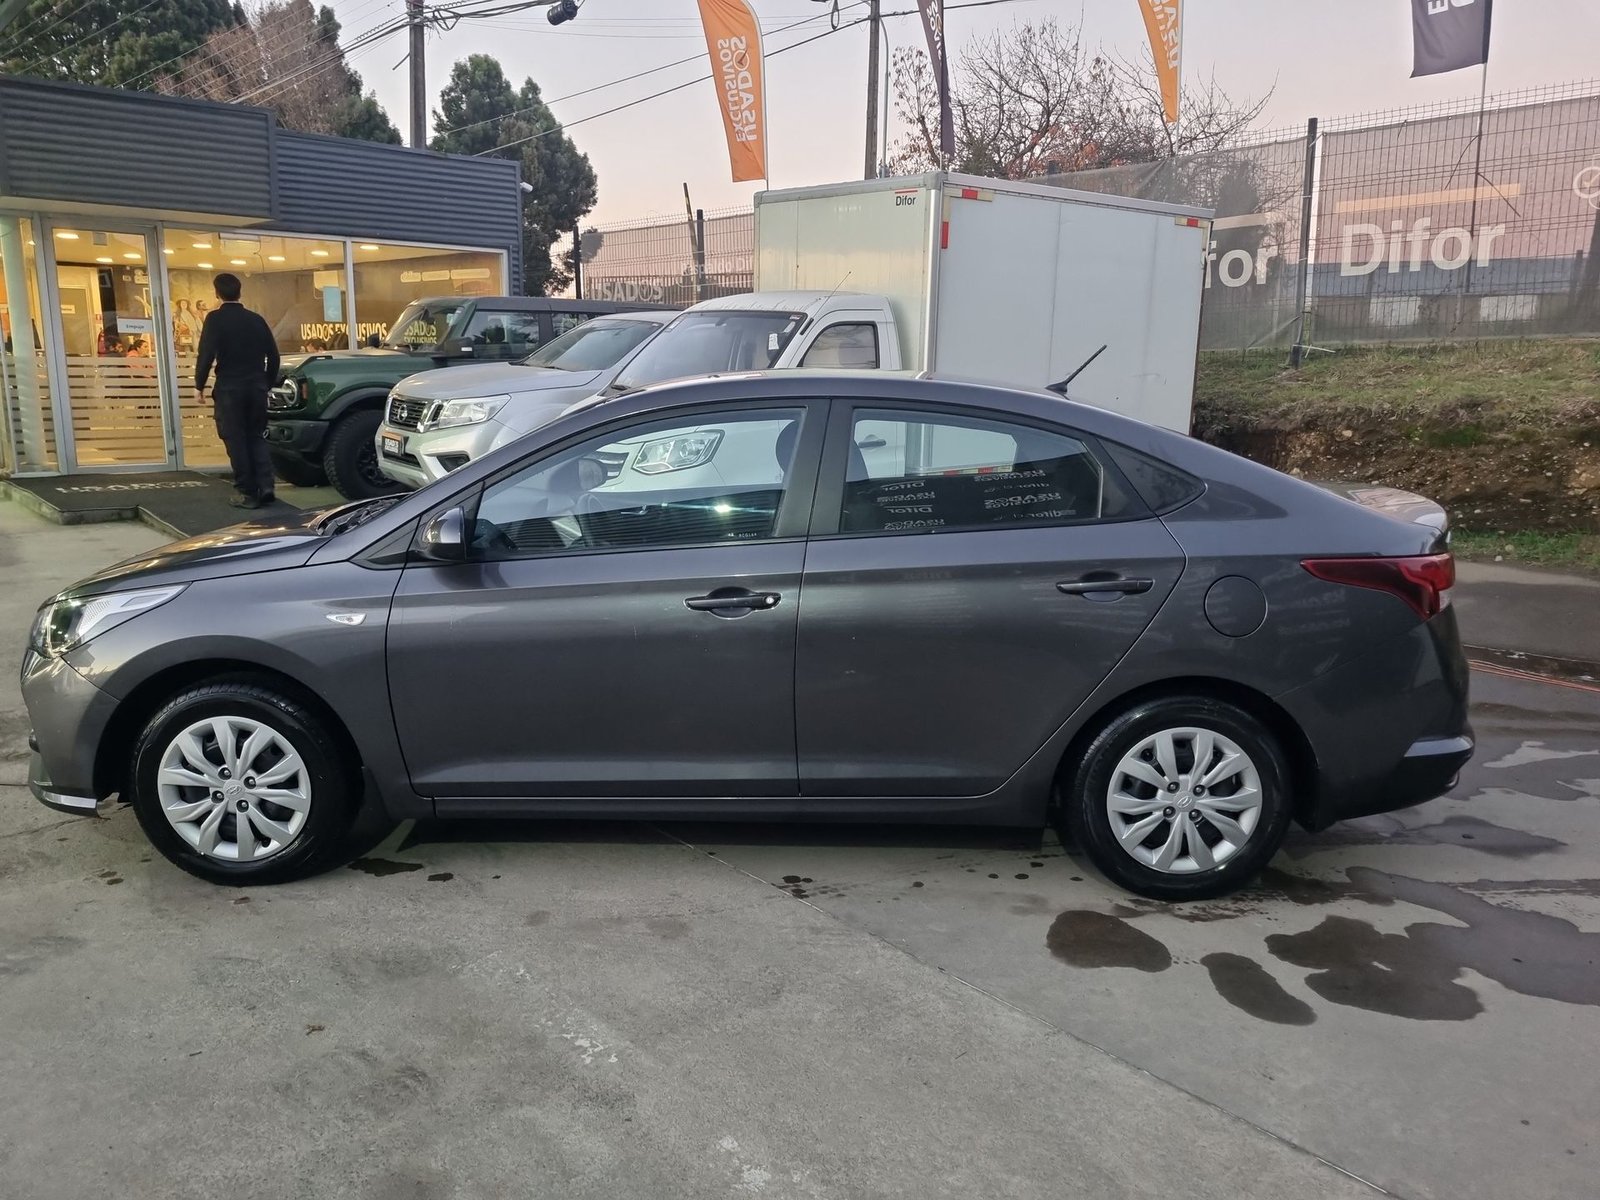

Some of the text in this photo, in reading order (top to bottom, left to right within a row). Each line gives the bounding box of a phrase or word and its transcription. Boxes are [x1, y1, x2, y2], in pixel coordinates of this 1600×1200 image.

[895, 195, 916, 206] Difor
[1340, 217, 1505, 277] Difor
[1204, 240, 1279, 289] for
[590, 281, 664, 302] USADOS
[300, 322, 388, 342] USADOS EXCUSIVOS
